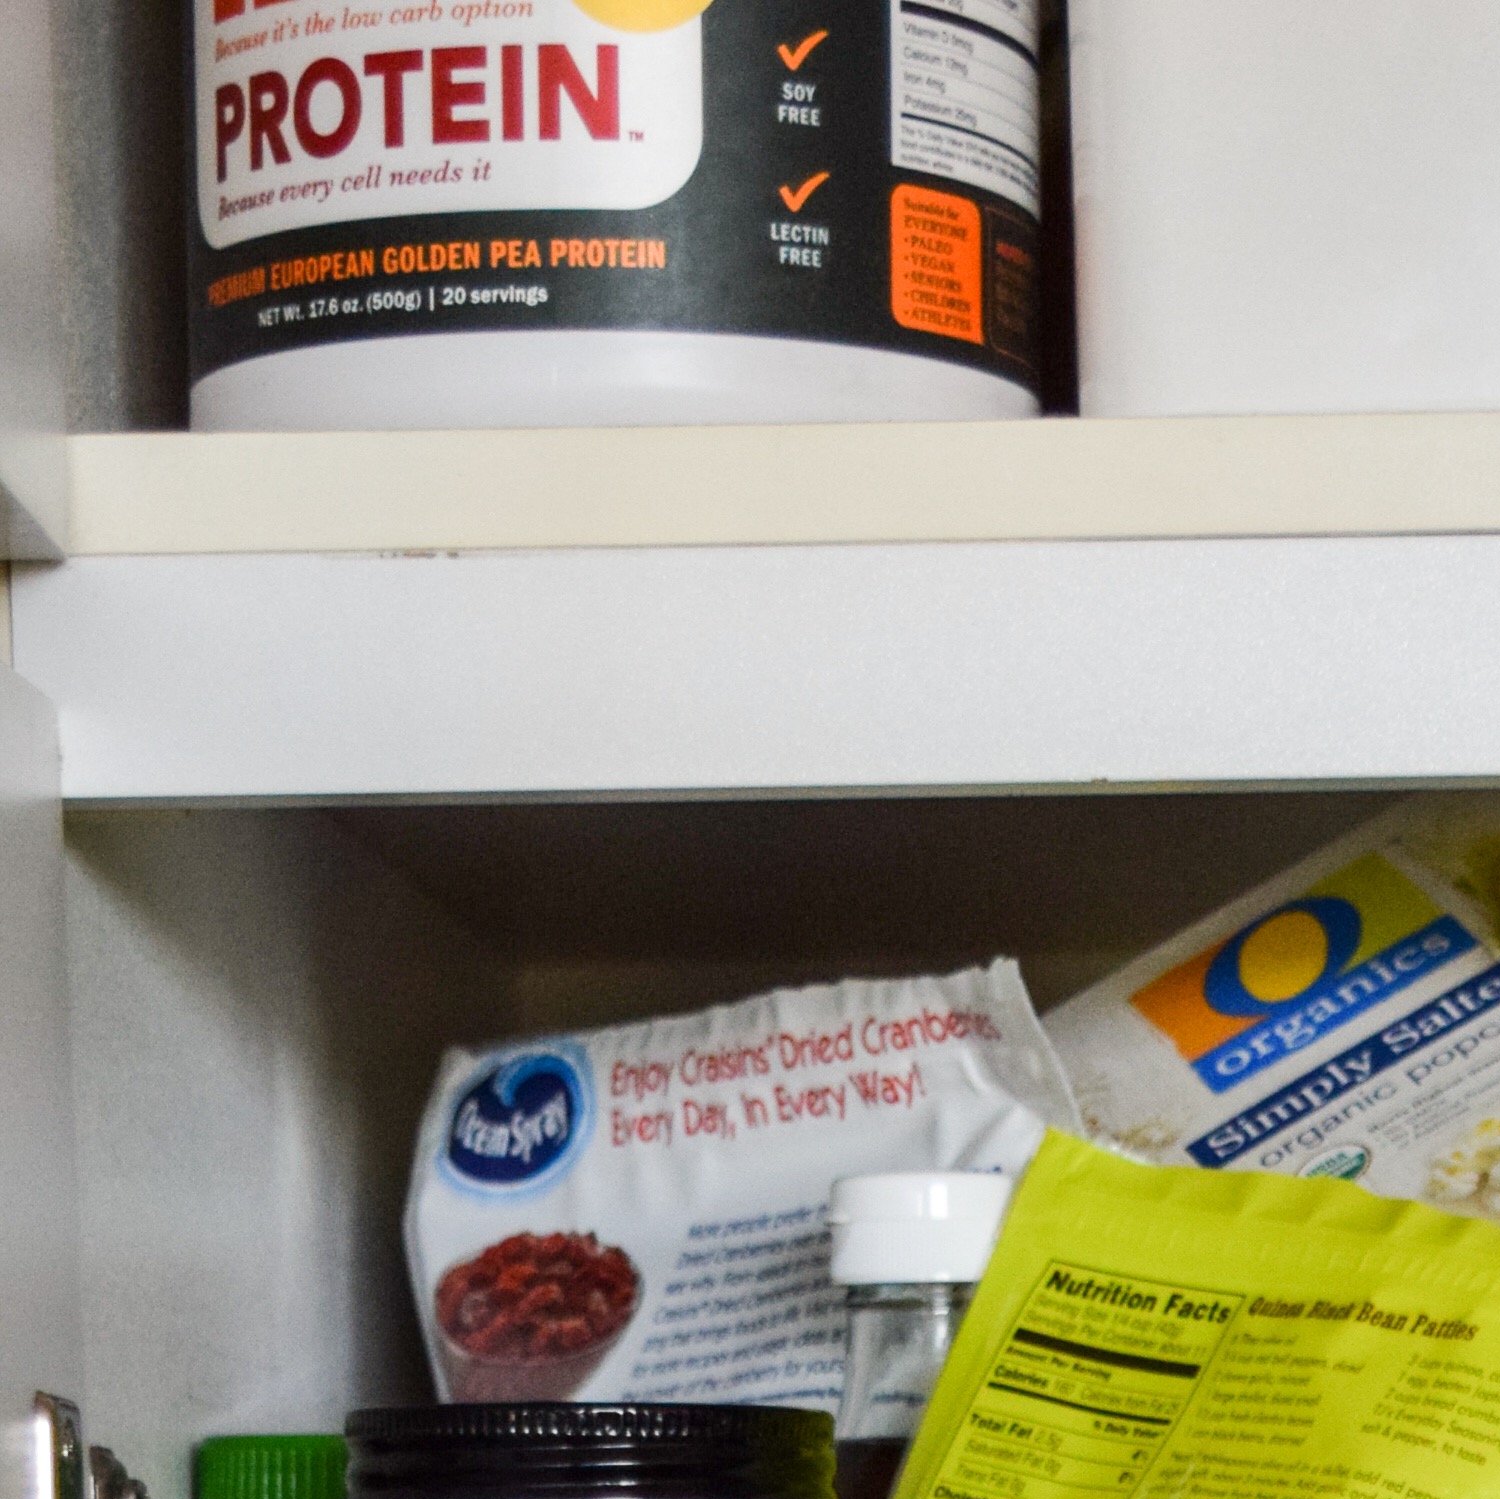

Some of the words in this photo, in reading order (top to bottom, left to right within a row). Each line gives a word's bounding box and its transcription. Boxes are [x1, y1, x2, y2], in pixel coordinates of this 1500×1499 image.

[305, 13, 335, 35] the
[342, 8, 382, 29] low
[390, 0, 442, 24] carb
[451, 0, 533, 26] option
[215, 45, 619, 183] PROTEIN
[777, 105, 821, 126] FREE
[782, 82, 817, 102] SOY
[280, 178, 333, 203] every
[342, 164, 381, 192] cell
[390, 160, 463, 187] needs
[473, 158, 492, 182] it
[770, 223, 830, 245] LECTIN
[779, 246, 822, 268] FREE
[270, 248, 375, 291] EUROPEAN
[383, 241, 479, 275] GOLDEN
[490, 239, 541, 268] PEA
[551, 239, 666, 269] PROTEIN
[258, 306, 281, 328] NET
[309, 297, 338, 318] 17.6
[341, 297, 364, 314] oz.
[366, 287, 422, 314] (500g)
[443, 286, 466, 305] 20
[470, 284, 549, 306] servings
[1216, 933, 1449, 1076] organics
[611, 1061, 672, 1101] Enjoy
[779, 1030, 854, 1069] Dried
[509, 1094, 567, 1163] Spray
[611, 1108, 672, 1148] Every
[683, 1099, 735, 1138] Day,
[741, 1092, 768, 1125] In
[776, 1083, 847, 1121] Every
[849, 1064, 925, 1108] Way!
[1207, 1050, 1373, 1158] Simply
[1259, 1081, 1397, 1169] organic
[1045, 1270, 1157, 1312] Nutrition
[1163, 1293, 1231, 1325] Facts
[1355, 1302, 1409, 1334] Bean
[1414, 1314, 1479, 1342] Patties
